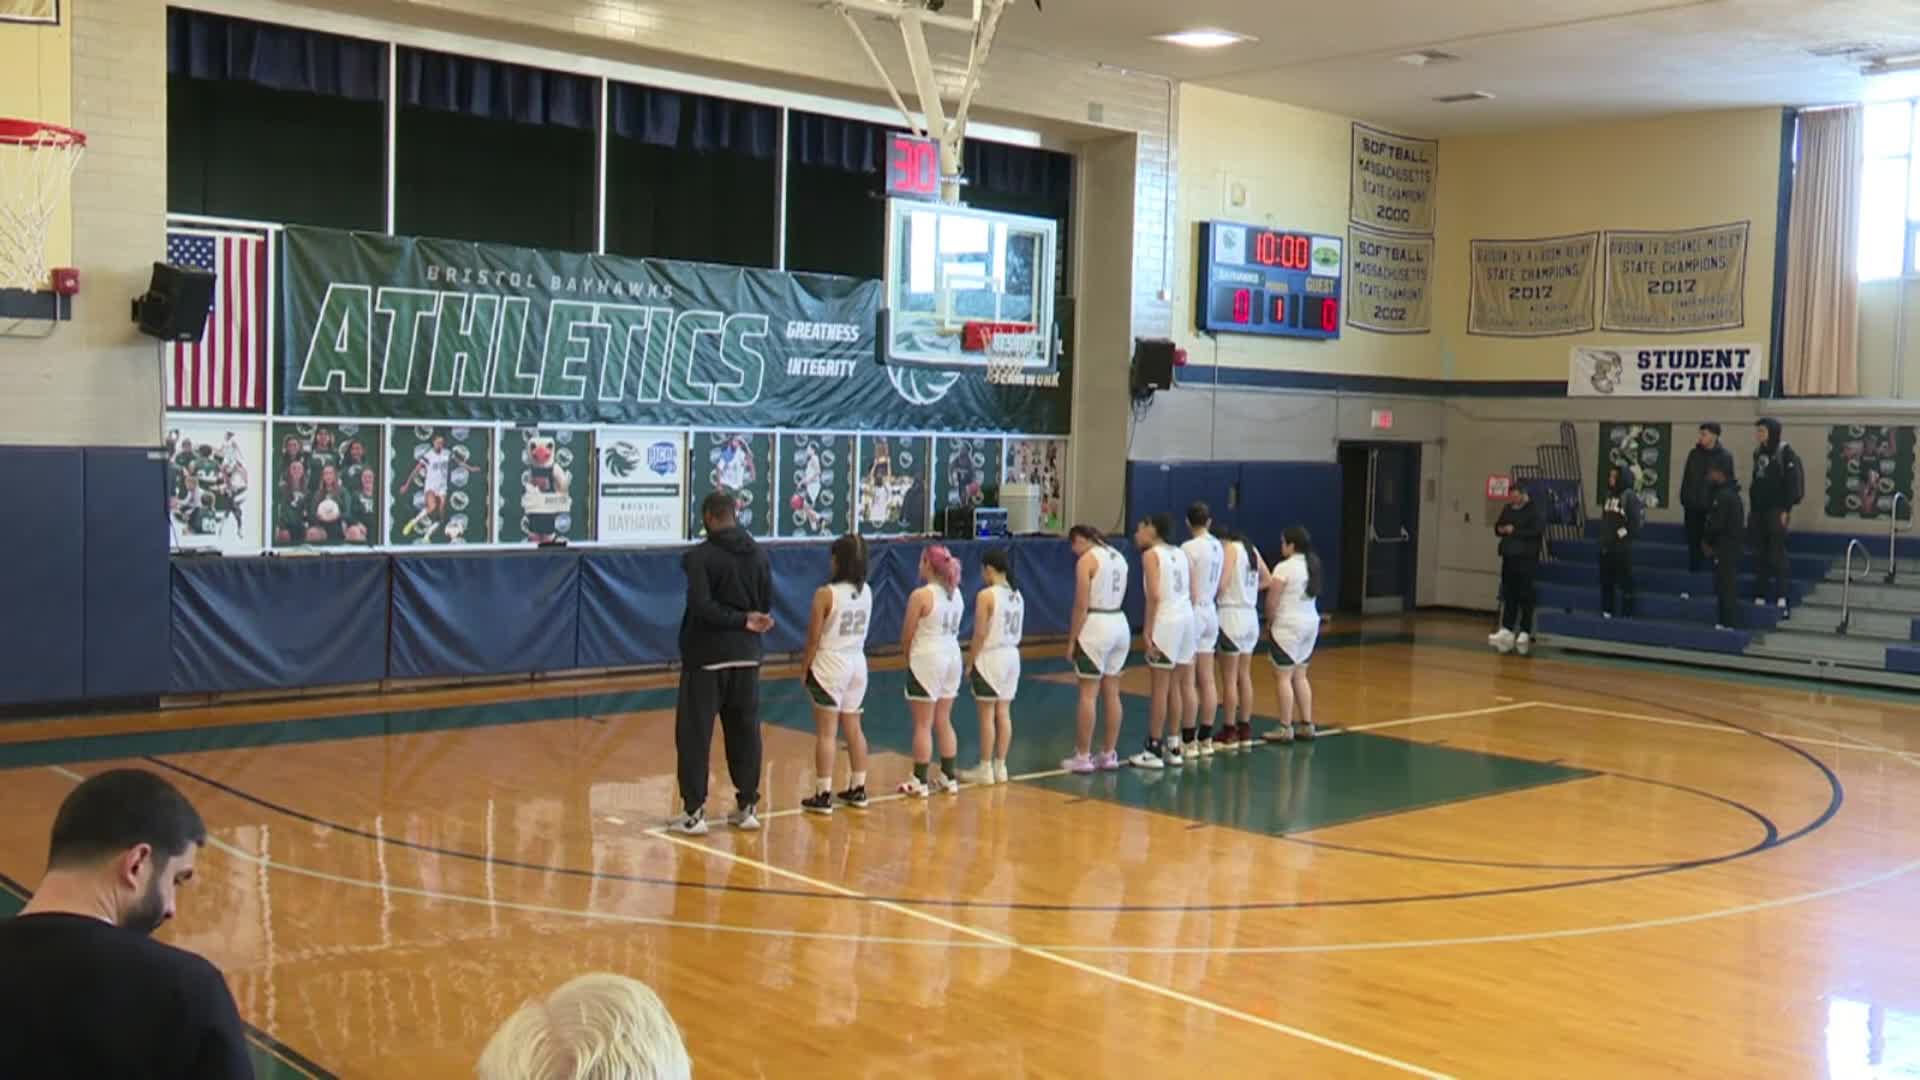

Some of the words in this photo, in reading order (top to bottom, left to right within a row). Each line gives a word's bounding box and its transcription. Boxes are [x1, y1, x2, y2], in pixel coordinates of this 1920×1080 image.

[1362, 137, 1429, 163] SOFTBALL
[892, 139, 937, 193] 30
[1256, 232, 1309, 270] 10:00
[1359, 240, 1425, 262] SOFTBALL
[1487, 266, 1517, 281] STATE
[1520, 263, 1579, 281] CHAMPIONS
[1622, 260, 1657, 275] STATE
[1662, 256, 1728, 274] CHAMPIONS
[426, 264, 537, 289] BRISTOL
[550, 274, 674, 299] BAYHAWKS
[1508, 284, 1553, 300] 2017
[1647, 279, 1697, 295] 2017
[1231, 287, 1250, 324] 0
[1321, 297, 1338, 333] 0
[785, 320, 861, 343] GREATNESS
[297, 282, 769, 407] ATHLETICS
[786, 356, 857, 378] INTEGRITY
[1637, 349, 1751, 370] STUDENT
[1640, 371, 1744, 392] SECTION
[839, 608, 866, 637] 22
